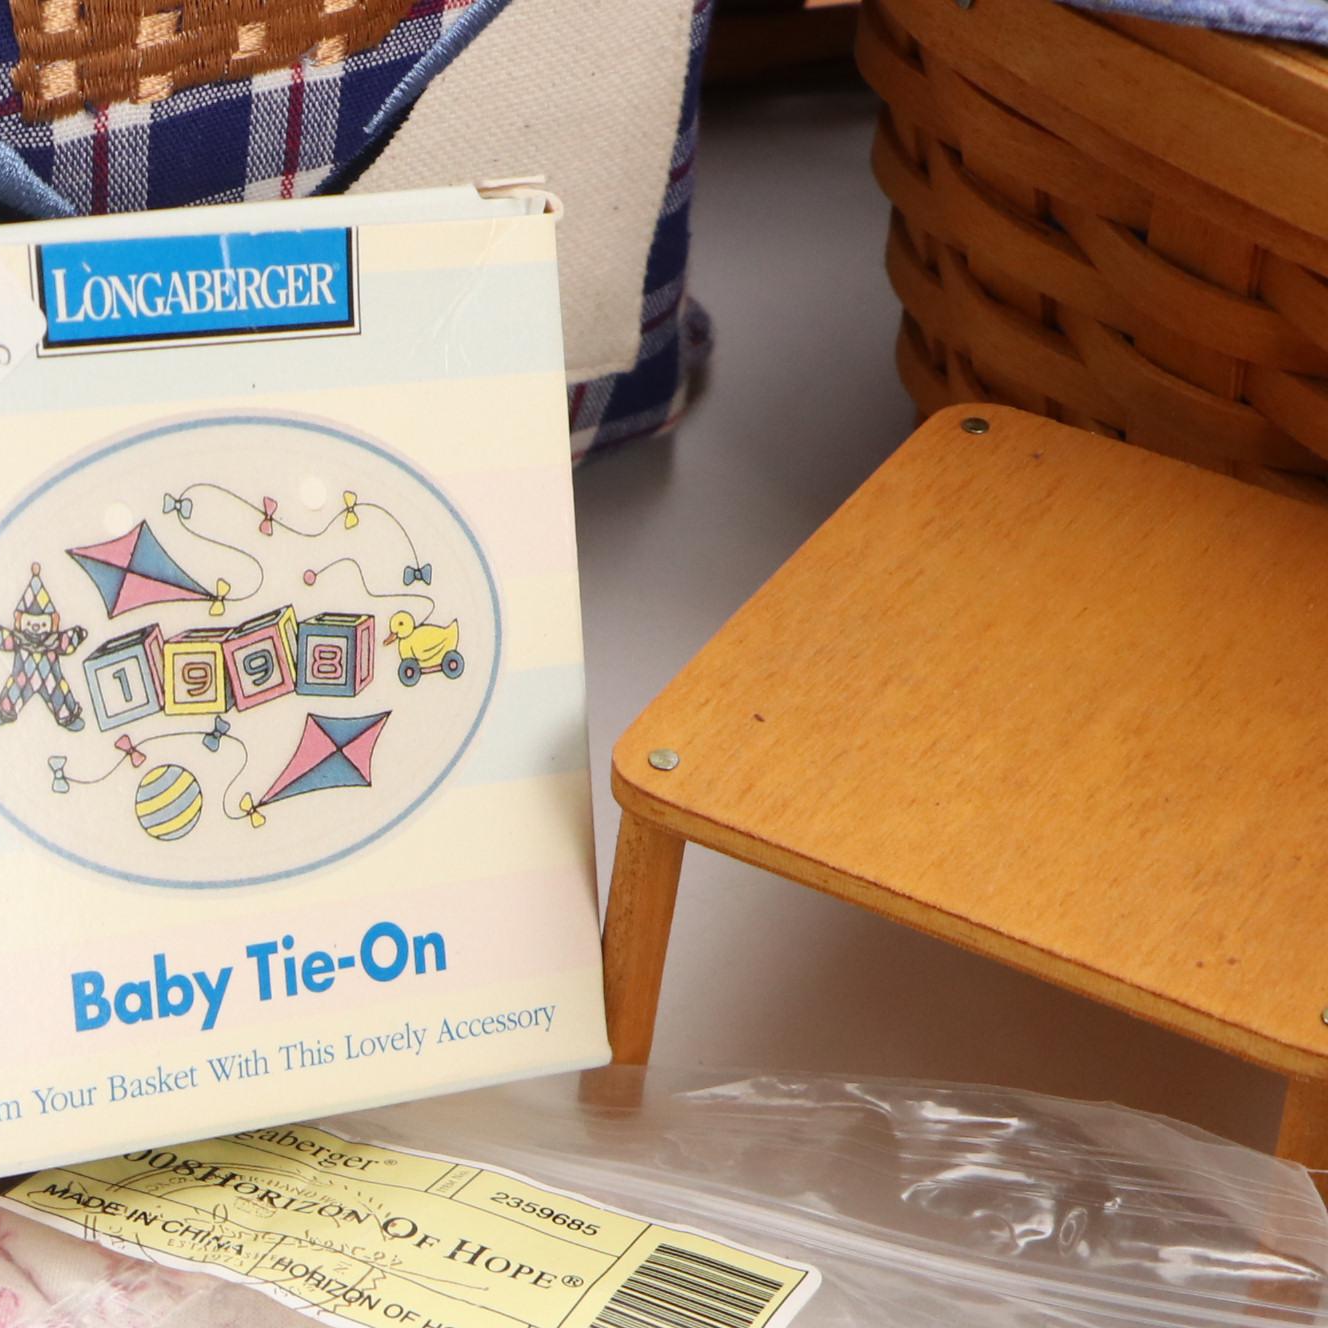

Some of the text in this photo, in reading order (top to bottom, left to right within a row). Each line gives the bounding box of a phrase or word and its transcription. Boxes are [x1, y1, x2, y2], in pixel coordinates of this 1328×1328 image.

[71, 920, 447, 1032] Baby Tie-On
[32, 1086, 98, 1115] Your
[108, 1065, 198, 1103] Basket
[207, 1049, 270, 1083] With
[278, 1039, 336, 1071] This
[344, 1021, 427, 1061] Lovely
[437, 1004, 556, 1044] Accessory
[41, 1181, 125, 1217] MADE
[125, 1208, 159, 1227] IN
[160, 1219, 244, 1256] CHINA
[490, 1192, 600, 1236] 2359685
[270, 1256, 382, 1311] HORIZON
[382, 1303, 421, 1323] OF
